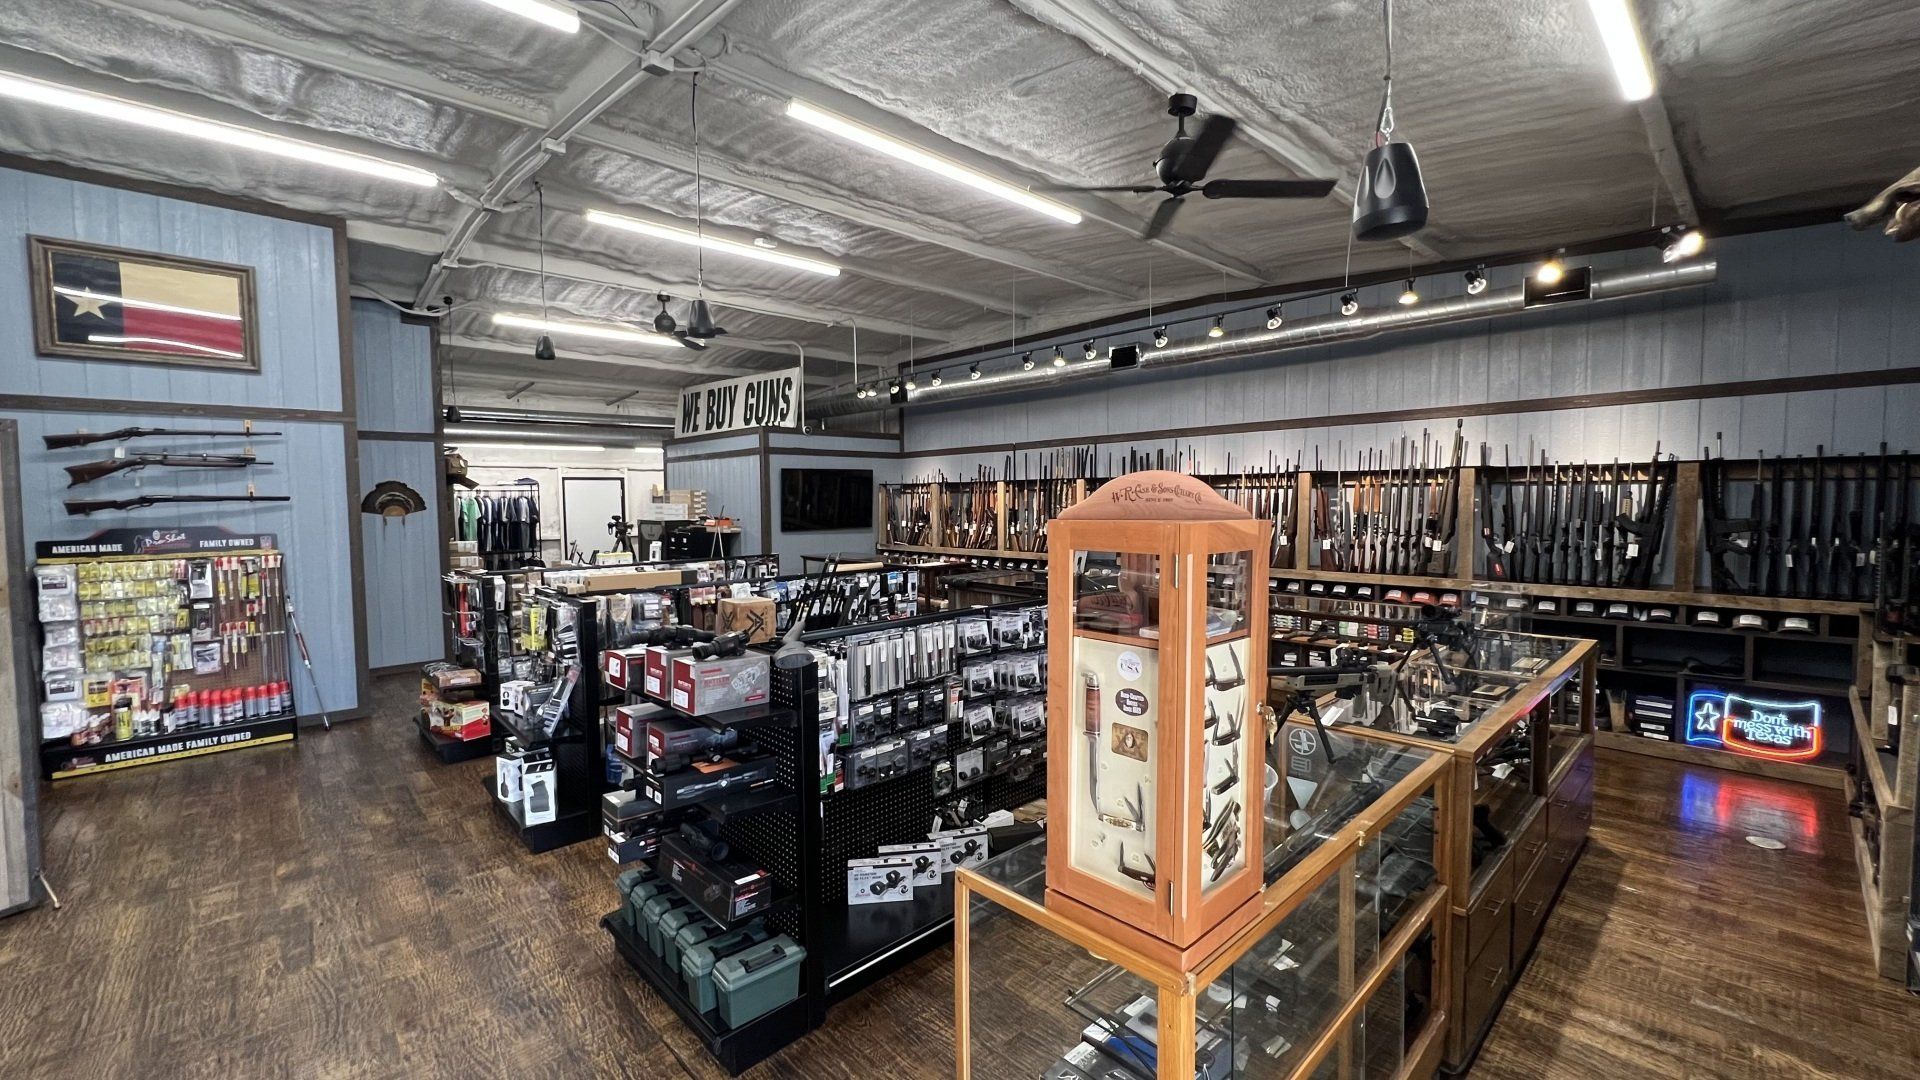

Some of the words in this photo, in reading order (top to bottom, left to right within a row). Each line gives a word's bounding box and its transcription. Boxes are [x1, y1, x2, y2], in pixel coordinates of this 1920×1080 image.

[682, 391, 701, 433] WE
[706, 385, 738, 430] BUY
[743, 377, 792, 426] GUNS
[52, 545, 97, 554] AMERICAN
[99, 543, 123, 552] MADE
[199, 539, 227, 548] FAMILY
[228, 538, 254, 547] OWNED
[1751, 710, 1788, 726] Don't
[1733, 718, 1772, 733] mess
[1773, 724, 1812, 739] with
[1745, 729, 1791, 744] Texas
[105, 749, 155, 762] AMERICAN
[157, 743, 184, 755] MADE
[186, 737, 219, 749] FAMILY
[220, 731, 251, 743] OWNED
